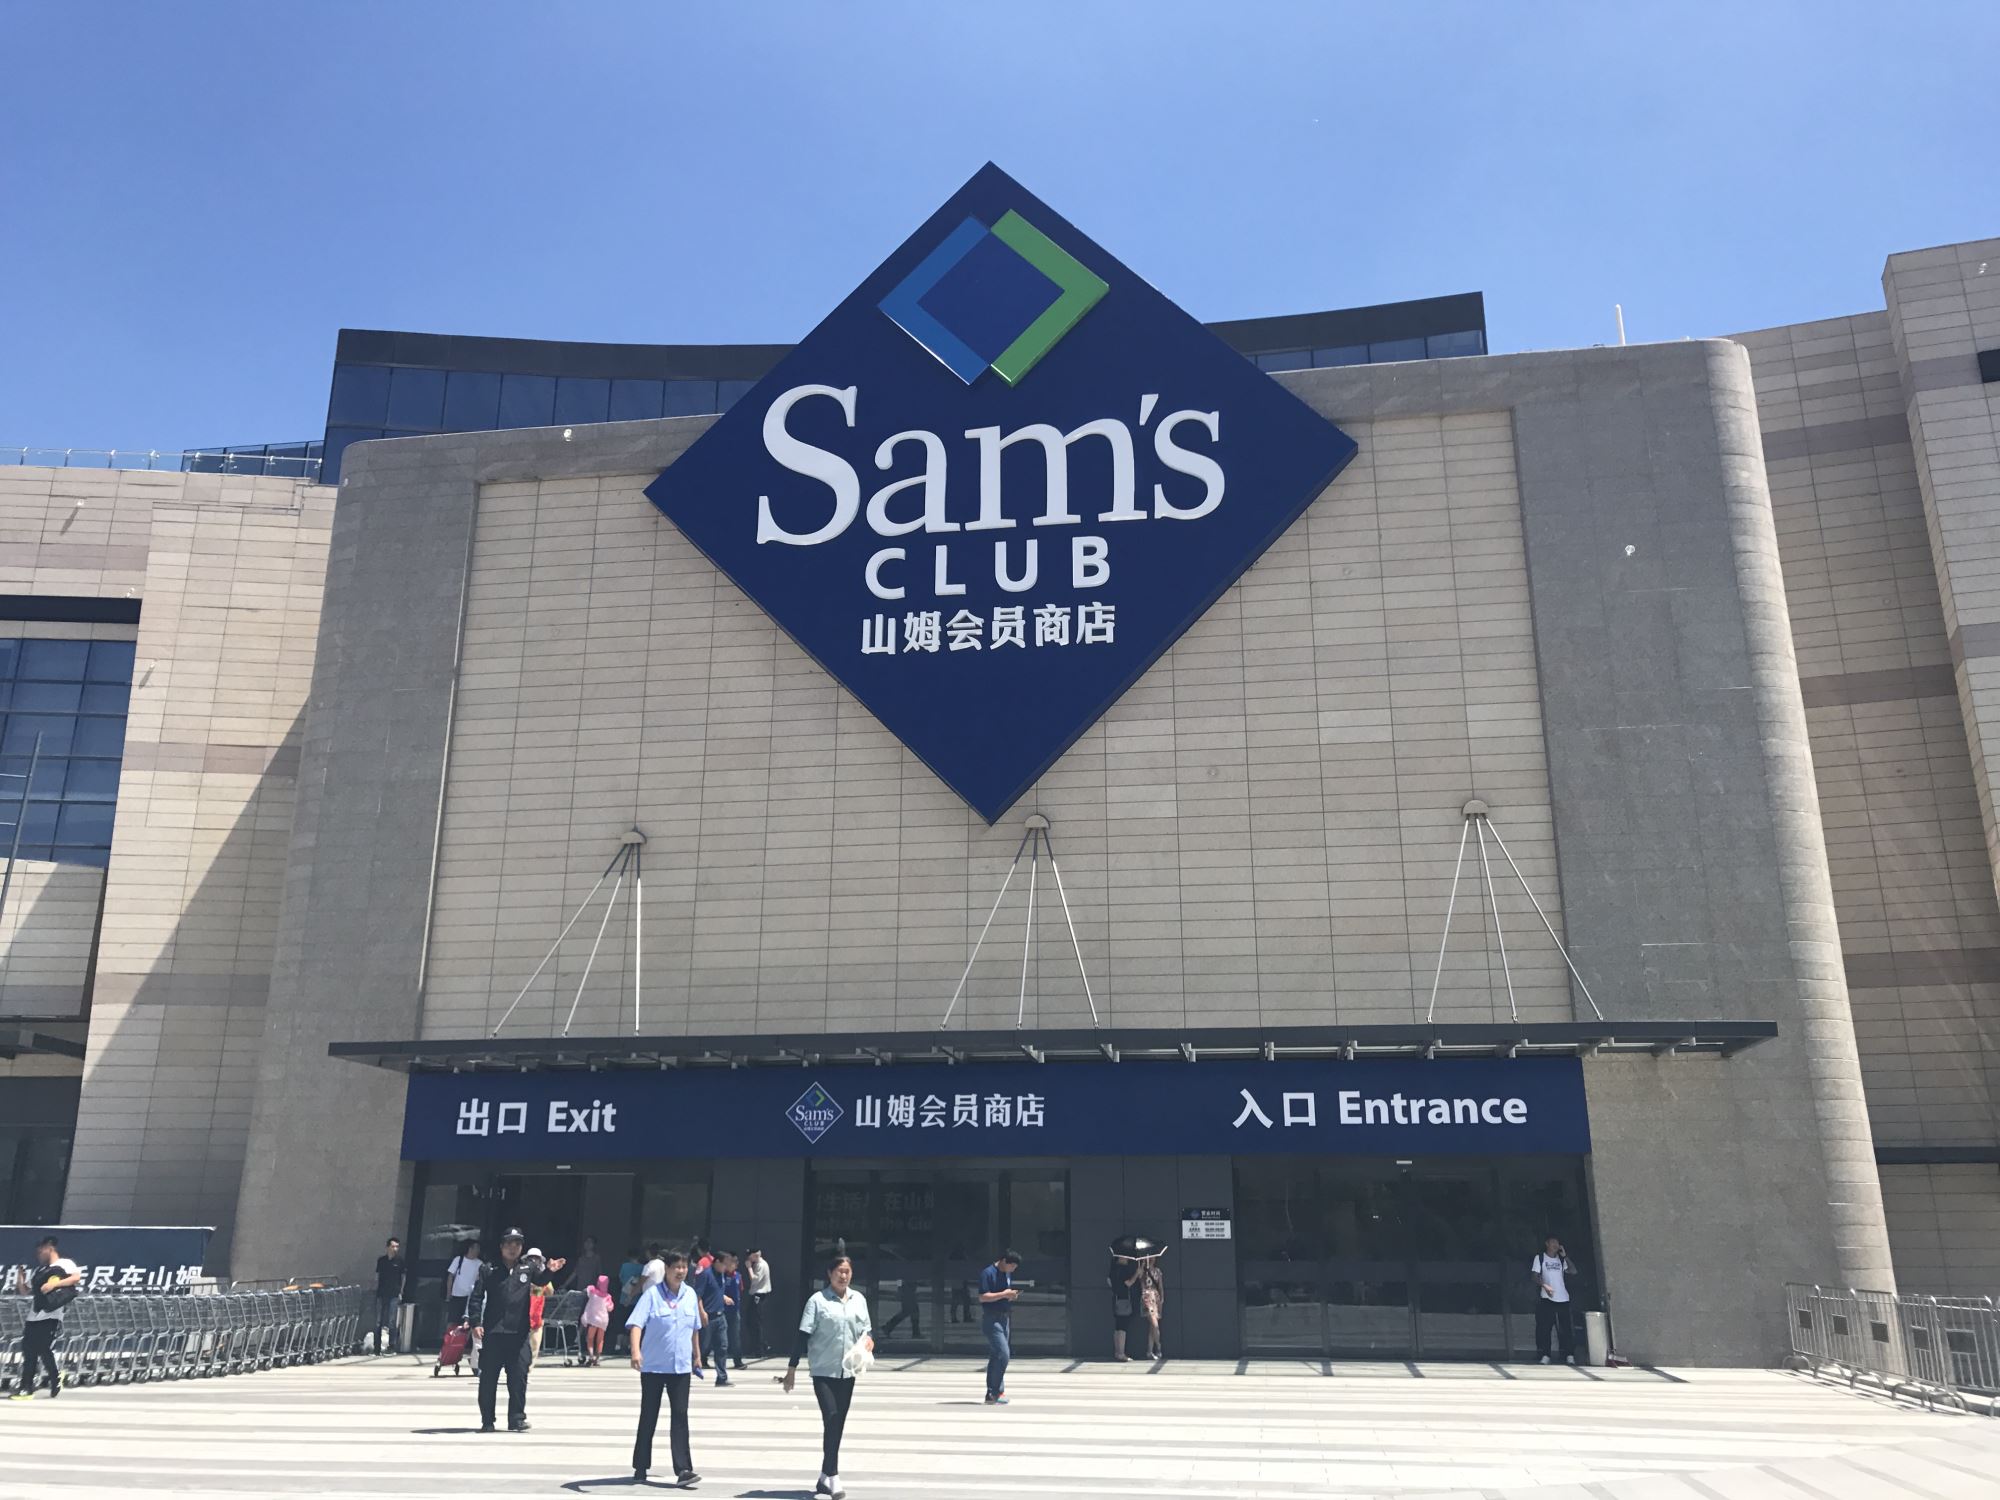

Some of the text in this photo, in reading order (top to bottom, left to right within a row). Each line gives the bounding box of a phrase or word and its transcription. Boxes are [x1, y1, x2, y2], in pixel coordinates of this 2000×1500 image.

[756, 384, 1226, 546] Sam's
[865, 536, 1110, 600] CLUB
[860, 602, 1116, 655] 山姆会员商店
[456, 1098, 617, 1137] 出口 Exit
[855, 1093, 1046, 1128] 山姆会员商店
[1232, 1088, 1528, 1129] 入口 Entrance
